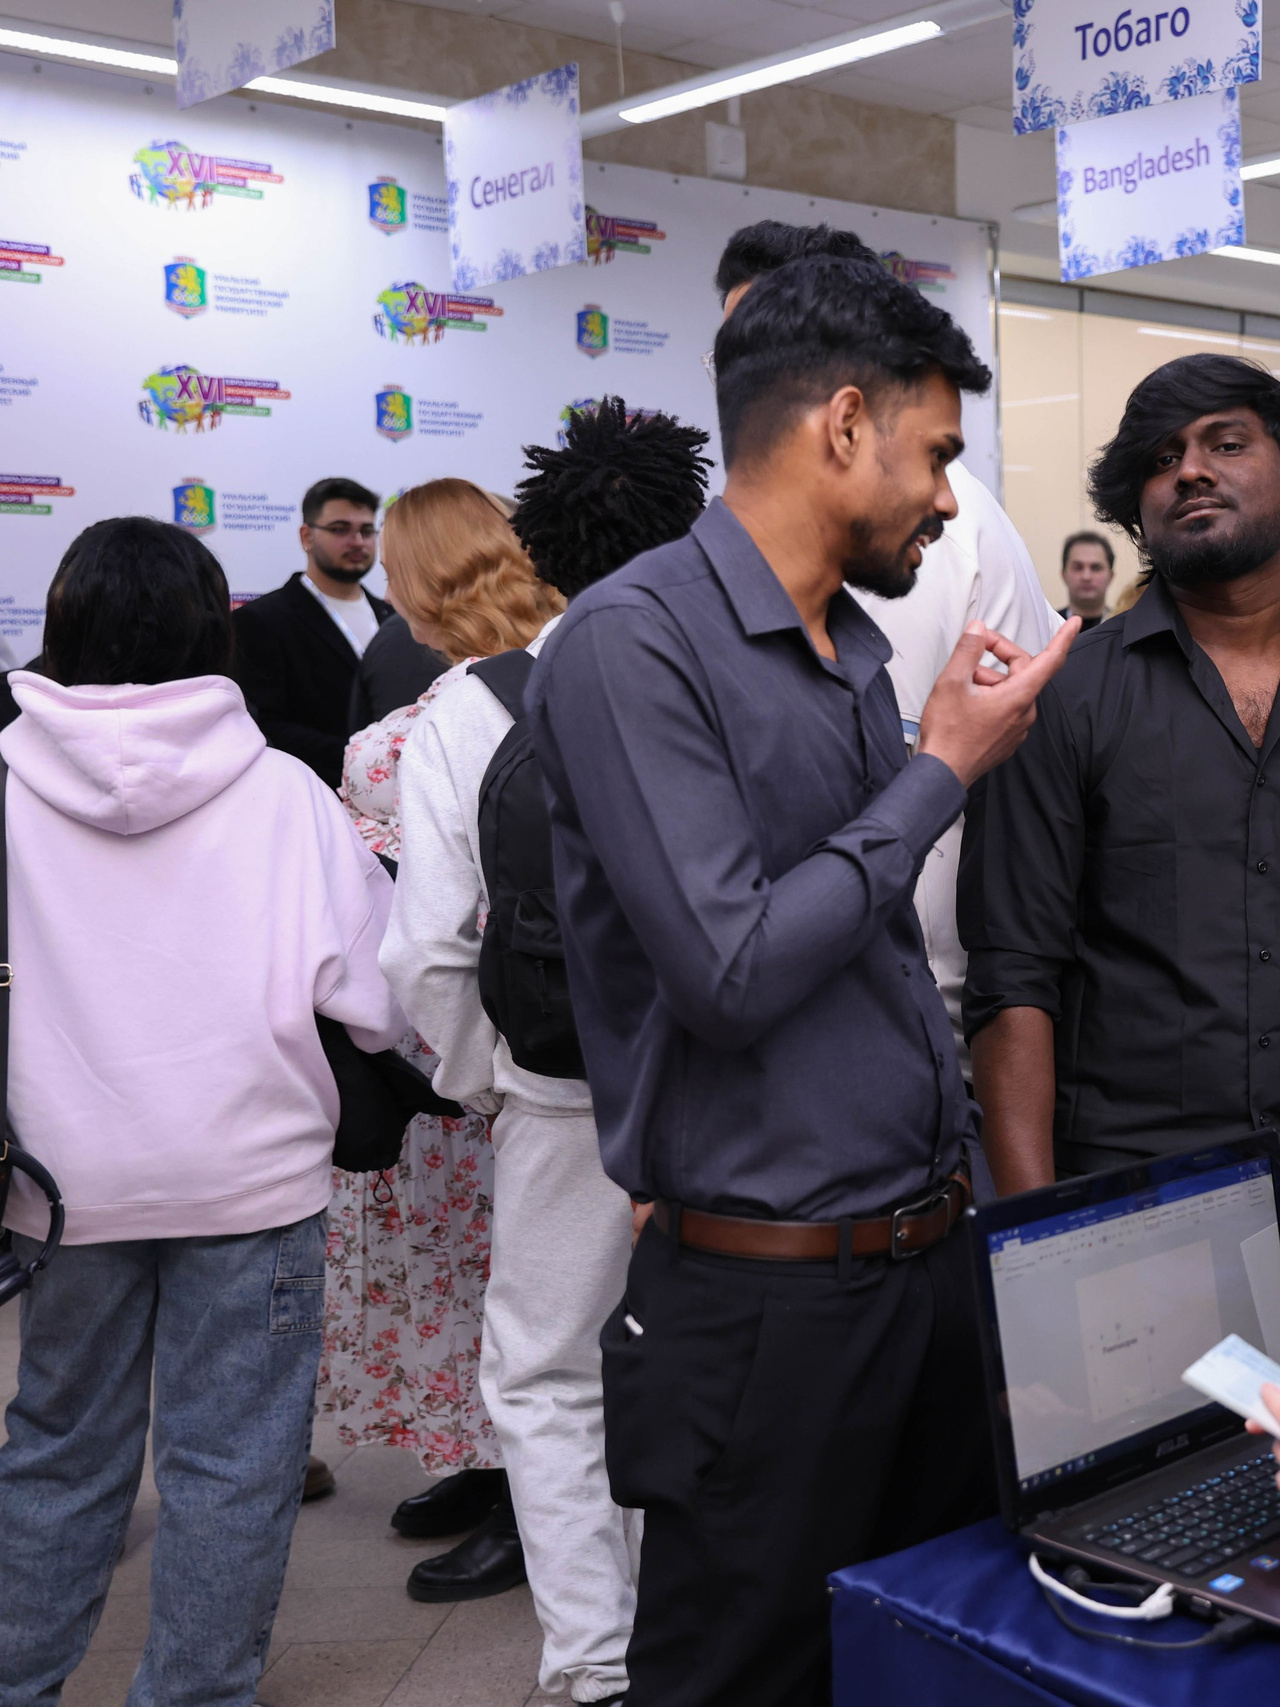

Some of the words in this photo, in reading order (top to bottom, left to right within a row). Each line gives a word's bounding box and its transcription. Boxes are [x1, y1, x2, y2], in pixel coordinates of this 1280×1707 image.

[1074, 6, 1190, 61] Тобаго
[470, 161, 555, 210] Сенегал
[1083, 137, 1211, 194] Bangladesh
[405, 290, 447, 318] XVI
[175, 374, 225, 404] XVI
